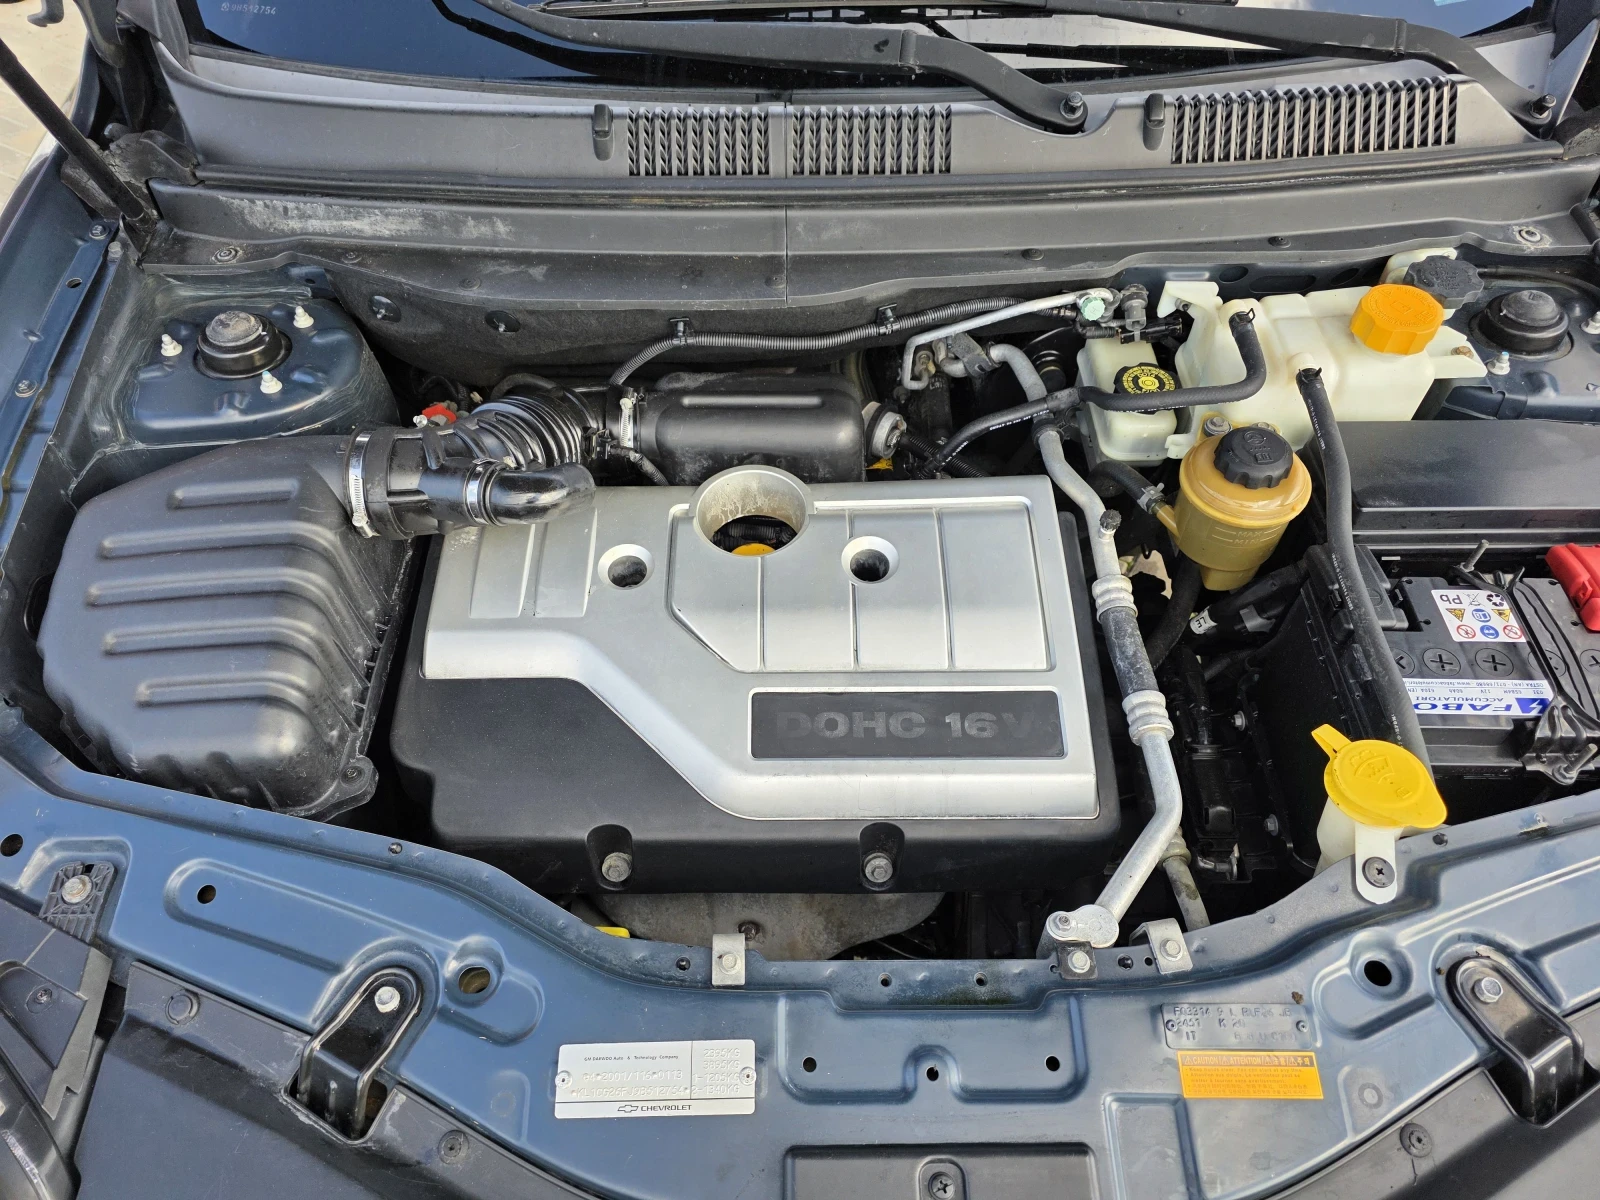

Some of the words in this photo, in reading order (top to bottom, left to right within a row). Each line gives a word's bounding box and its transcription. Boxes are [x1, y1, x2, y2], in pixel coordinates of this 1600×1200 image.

[1439, 594, 1463, 605] Pb
[1412, 702, 1513, 712] FABO
[777, 710, 927, 739] DOHC
[703, 1048, 741, 1058] 2395KG
[1192, 1056, 1219, 1065] CAUTION
[1229, 1056, 1261, 1065] ATTENTION
[640, 1104, 692, 1112] CHEVROLET
